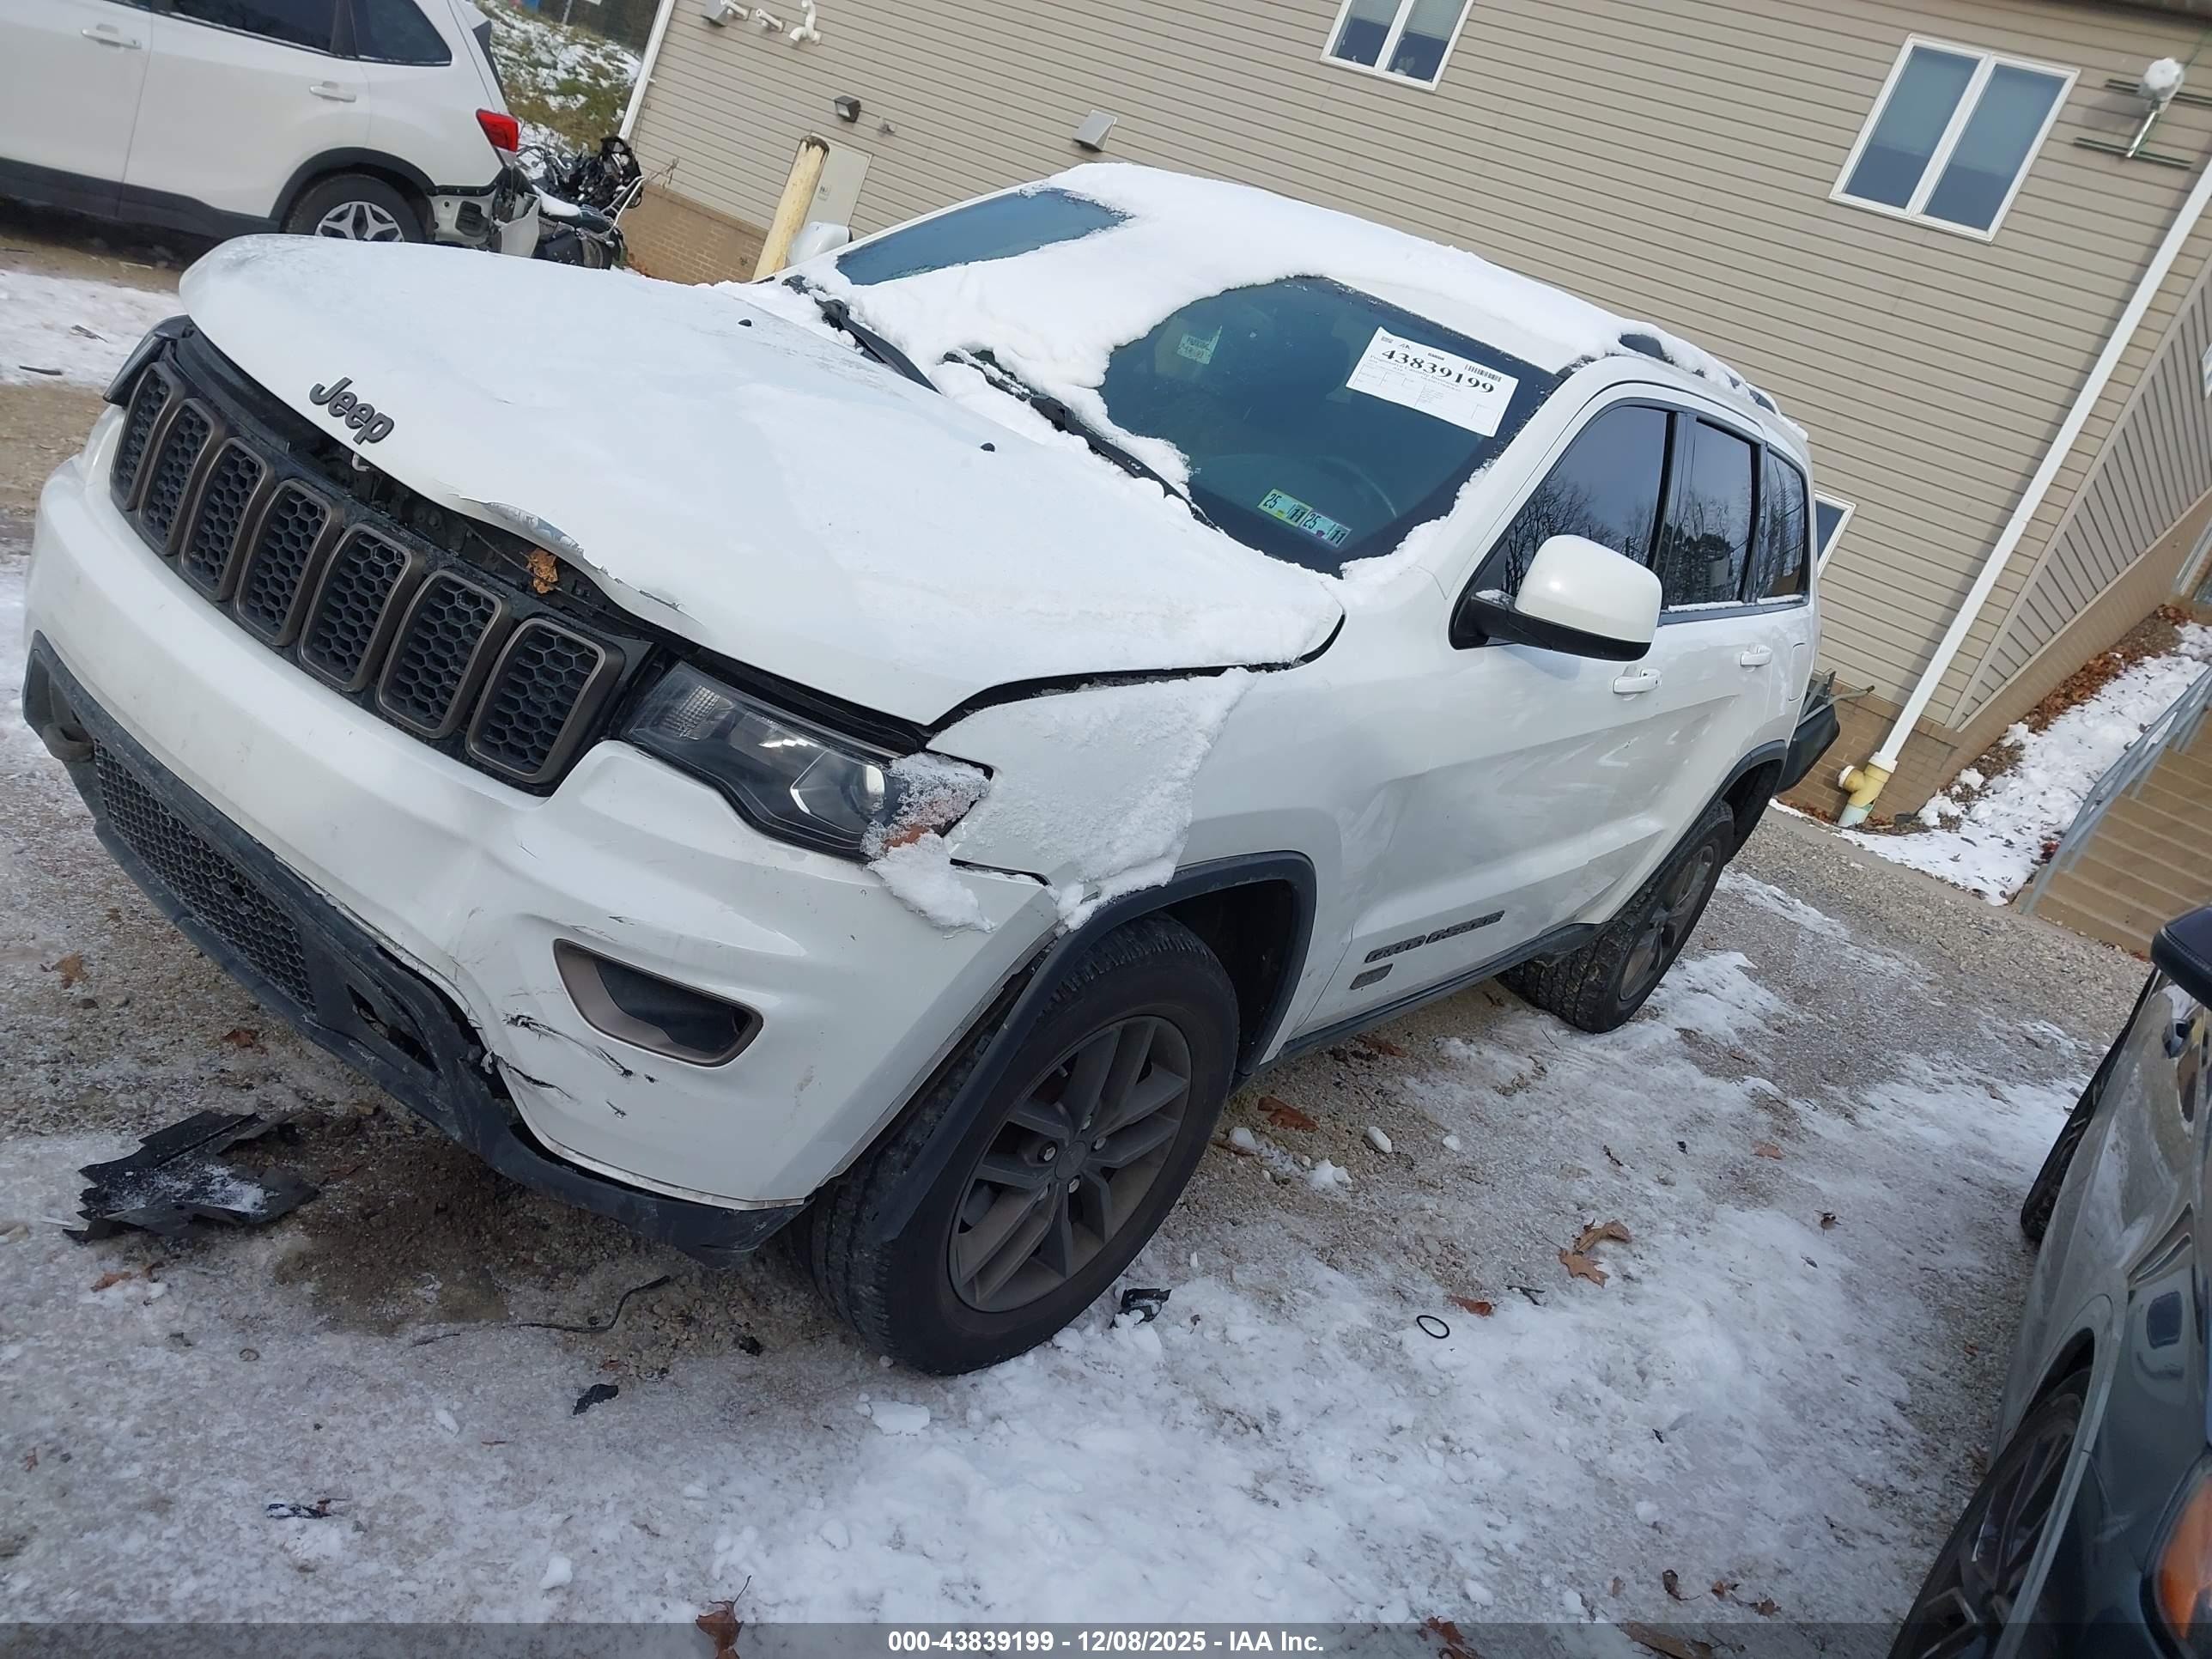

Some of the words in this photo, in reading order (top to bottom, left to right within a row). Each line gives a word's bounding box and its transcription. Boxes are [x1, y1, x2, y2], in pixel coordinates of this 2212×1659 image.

[1381, 349, 1495, 394] 43839199
[309, 376, 394, 446] Jeep
[1263, 493, 1282, 509] 25
[1304, 514, 1322, 530] 25
